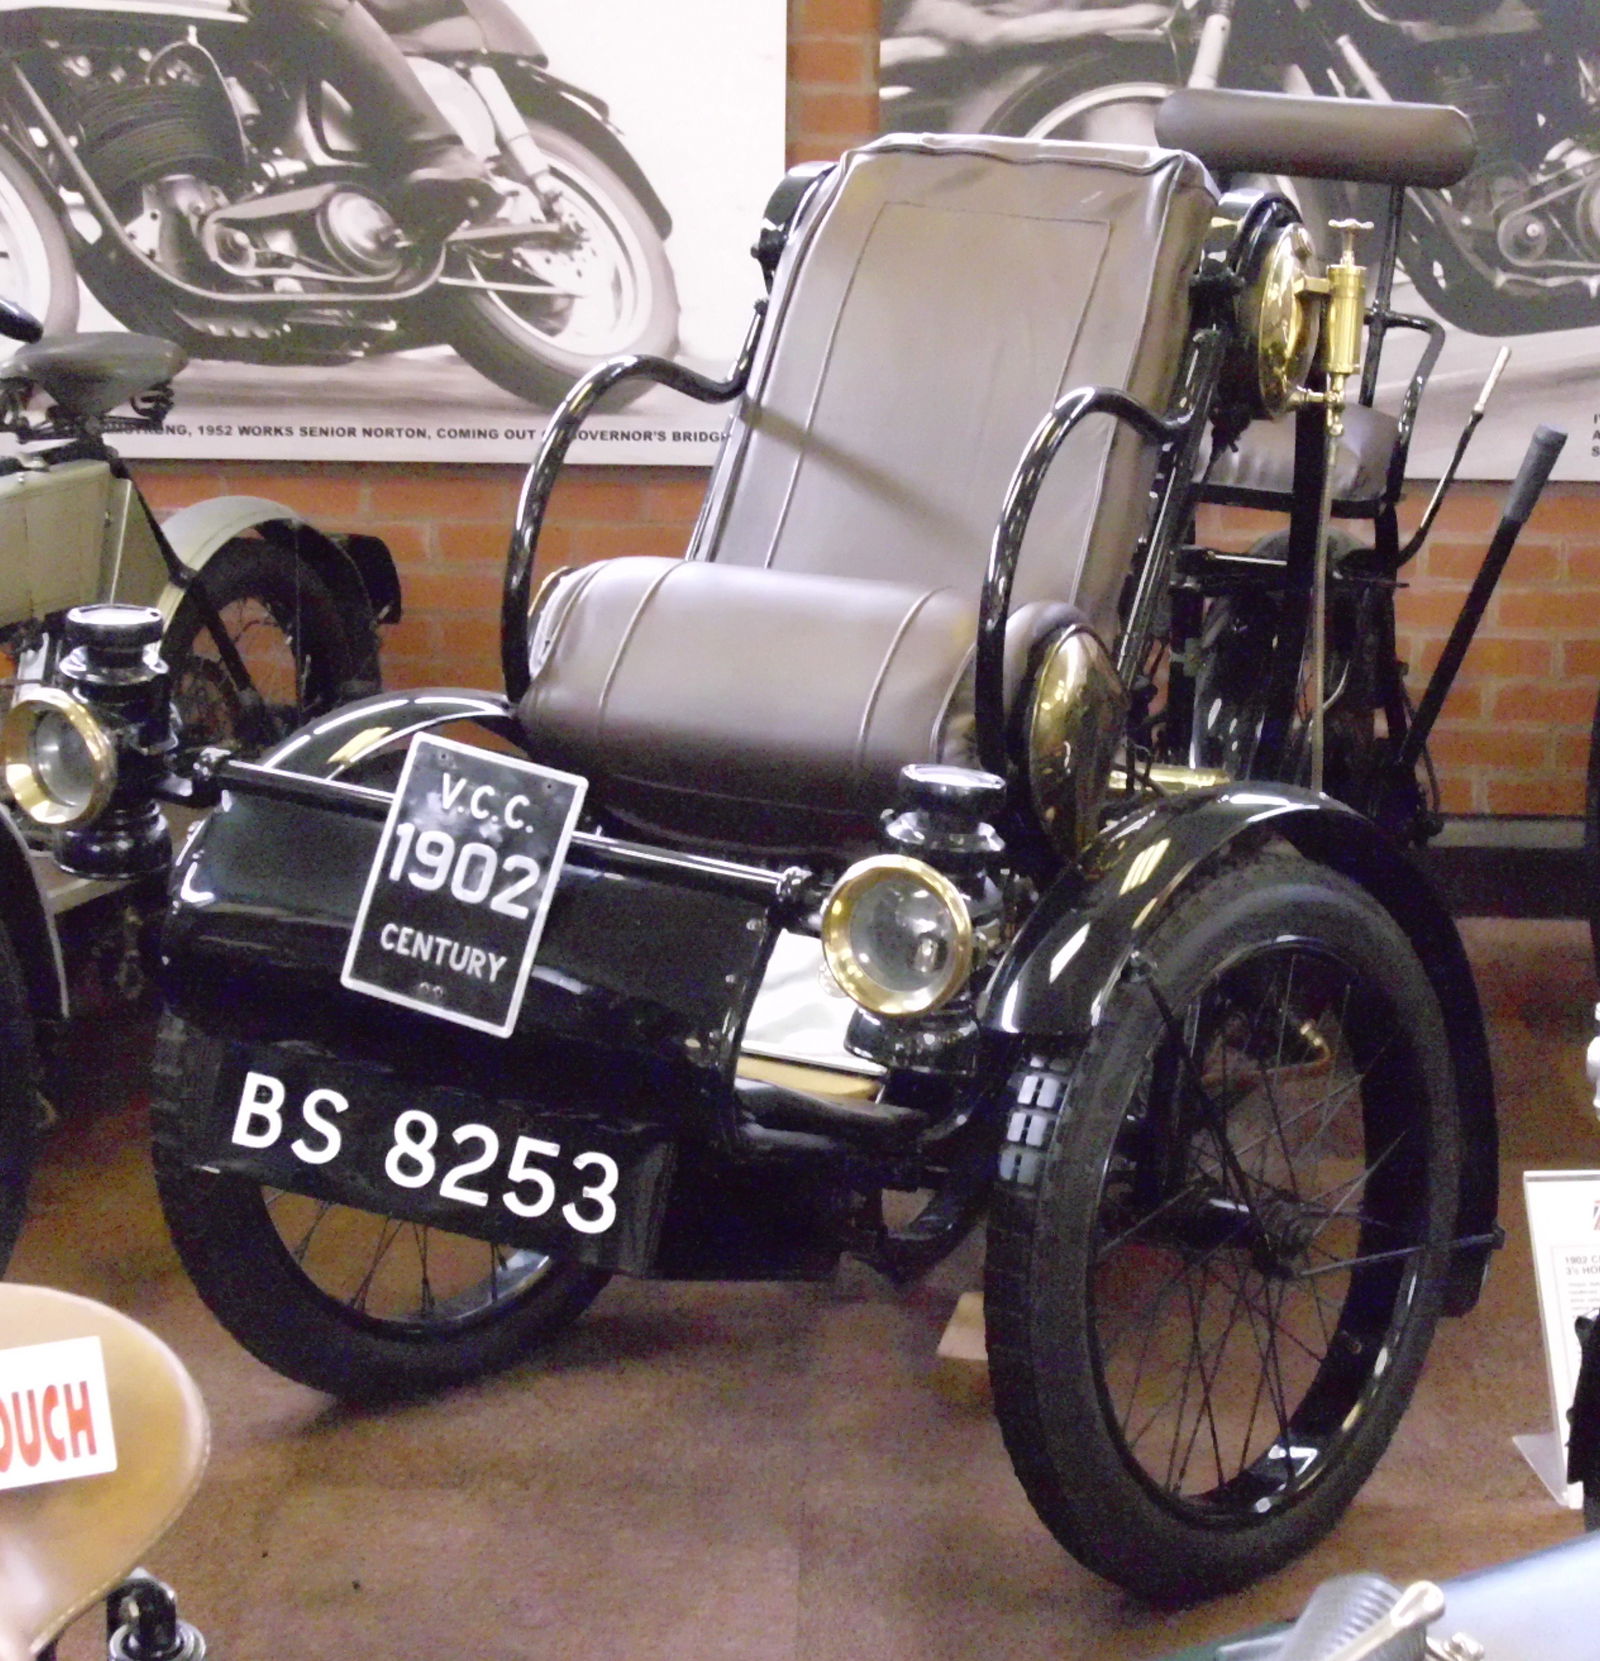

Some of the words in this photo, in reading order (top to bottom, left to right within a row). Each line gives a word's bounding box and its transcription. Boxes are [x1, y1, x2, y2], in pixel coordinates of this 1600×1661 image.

[198, 424, 233, 436] 1952
[238, 425, 294, 437] WORKS
[299, 426, 357, 437] SENIOR
[362, 427, 432, 440] NORTON,
[437, 428, 500, 440] COMING
[504, 429, 537, 440] OUT
[576, 430, 667, 442] OVERNOR'S
[441, 772, 534, 834] V.C.C.
[389, 822, 541, 920] 1902
[380, 922, 507, 983] CENTURY
[231, 1071, 349, 1165] BS
[385, 1109, 620, 1235] 8253
